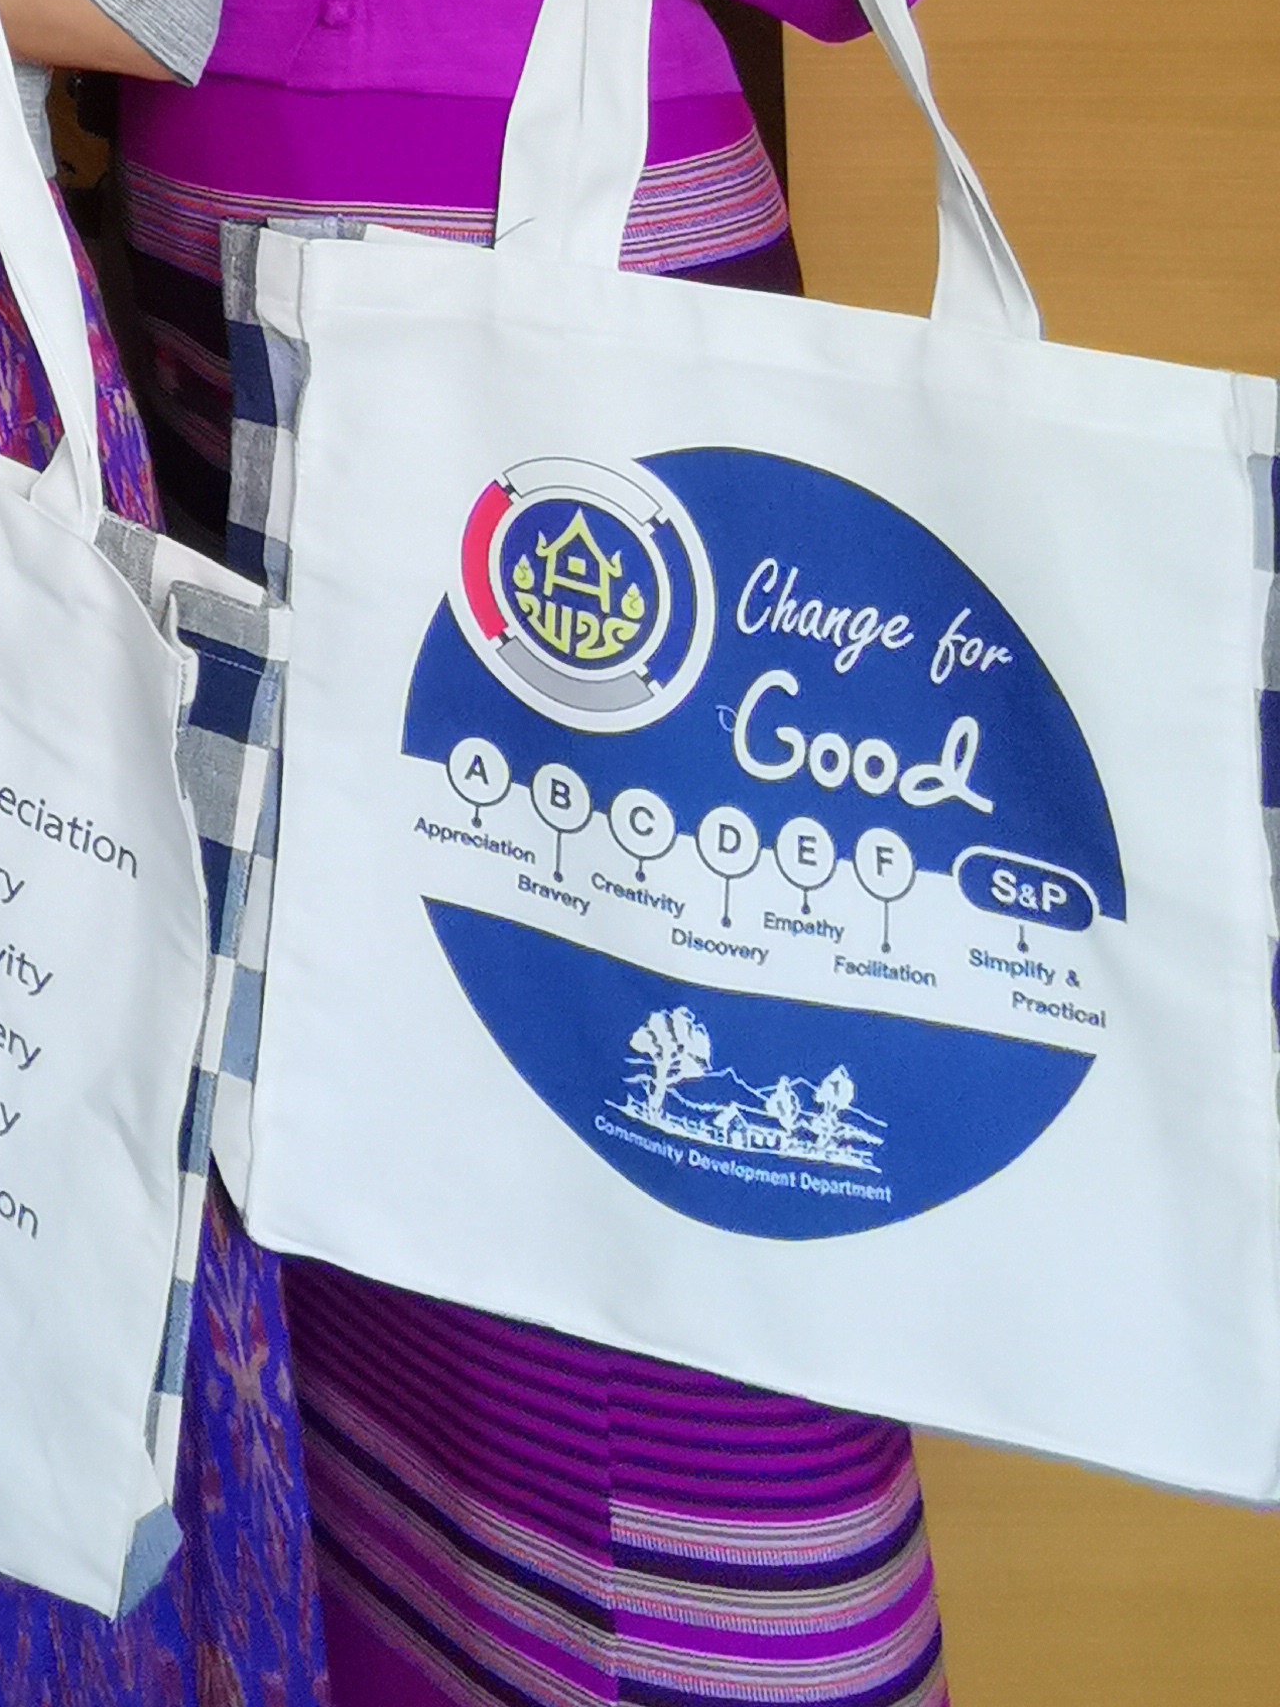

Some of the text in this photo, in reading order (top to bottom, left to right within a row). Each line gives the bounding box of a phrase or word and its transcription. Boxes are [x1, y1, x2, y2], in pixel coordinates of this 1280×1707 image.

[737, 558, 1013, 684] Change for
[734, 669, 993, 814] Good
[414, 816, 536, 865] Appreciation
[465, 755, 1067, 913] A B C D E F S&P
[517, 873, 591, 916] Bravery
[591, 872, 686, 919] Creativity
[671, 927, 769, 966] Discovery
[763, 911, 845, 944] Empathy
[833, 954, 937, 988] Facilitation
[969, 947, 1081, 989] Simplify &
[1012, 990, 1106, 1028] Practical
[594, 1115, 892, 1203] Community Development Department
